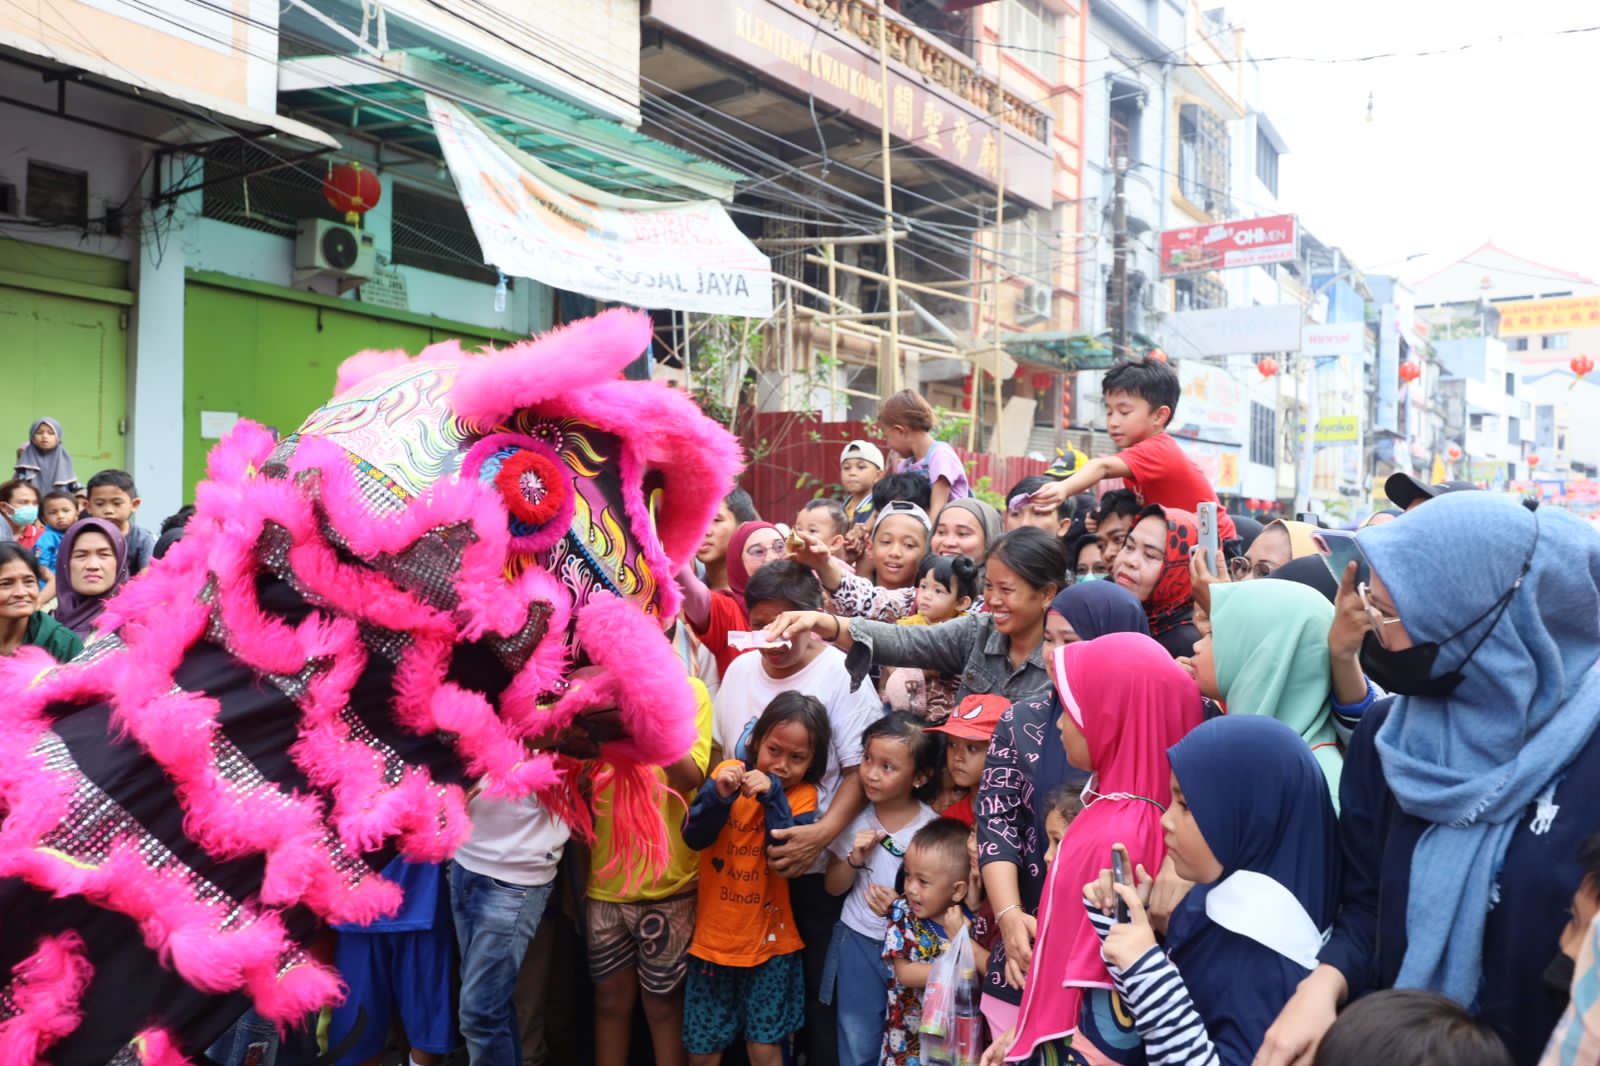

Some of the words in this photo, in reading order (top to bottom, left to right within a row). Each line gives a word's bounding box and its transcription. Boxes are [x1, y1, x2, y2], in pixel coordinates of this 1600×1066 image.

[735, 7, 809, 72] KLENTENG
[811, 48, 849, 91] KWAN
[849, 68, 883, 109] KONG
[695, 270, 750, 297] JAYA
[727, 865, 760, 882] Ayah
[719, 886, 761, 904] Bunda
